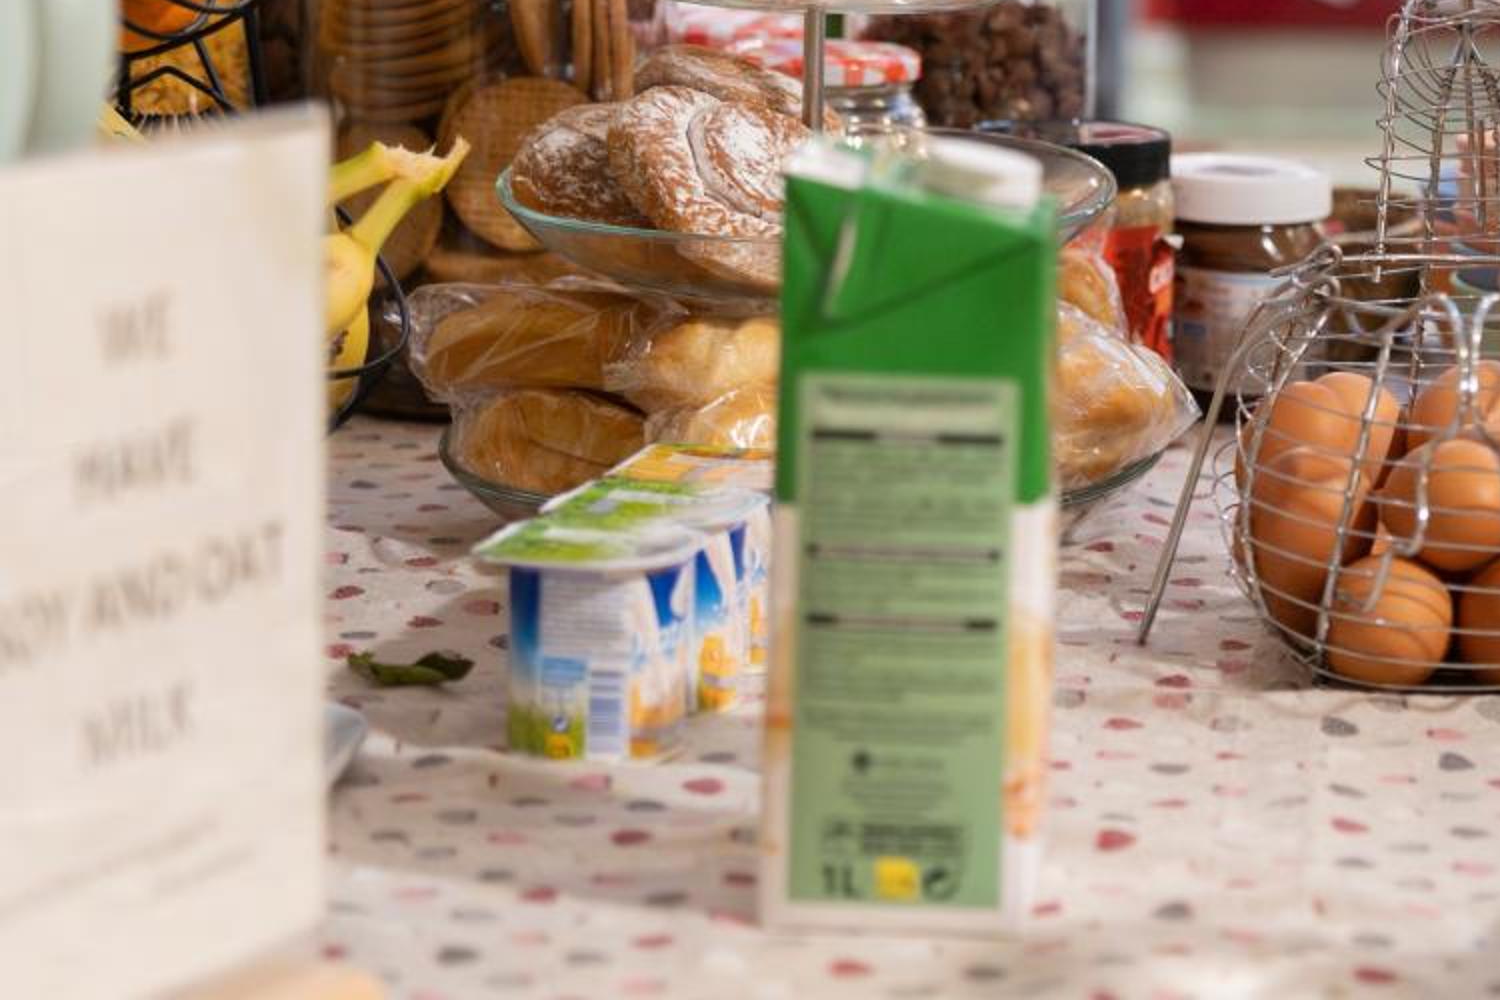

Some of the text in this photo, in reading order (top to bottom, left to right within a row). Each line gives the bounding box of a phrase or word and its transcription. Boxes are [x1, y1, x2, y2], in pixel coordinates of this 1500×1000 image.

[96, 287, 174, 369] WE
[72, 412, 197, 507] HAVE
[82, 552, 188, 638] AND
[193, 520, 285, 606] OAT
[80, 680, 194, 770] MILK
